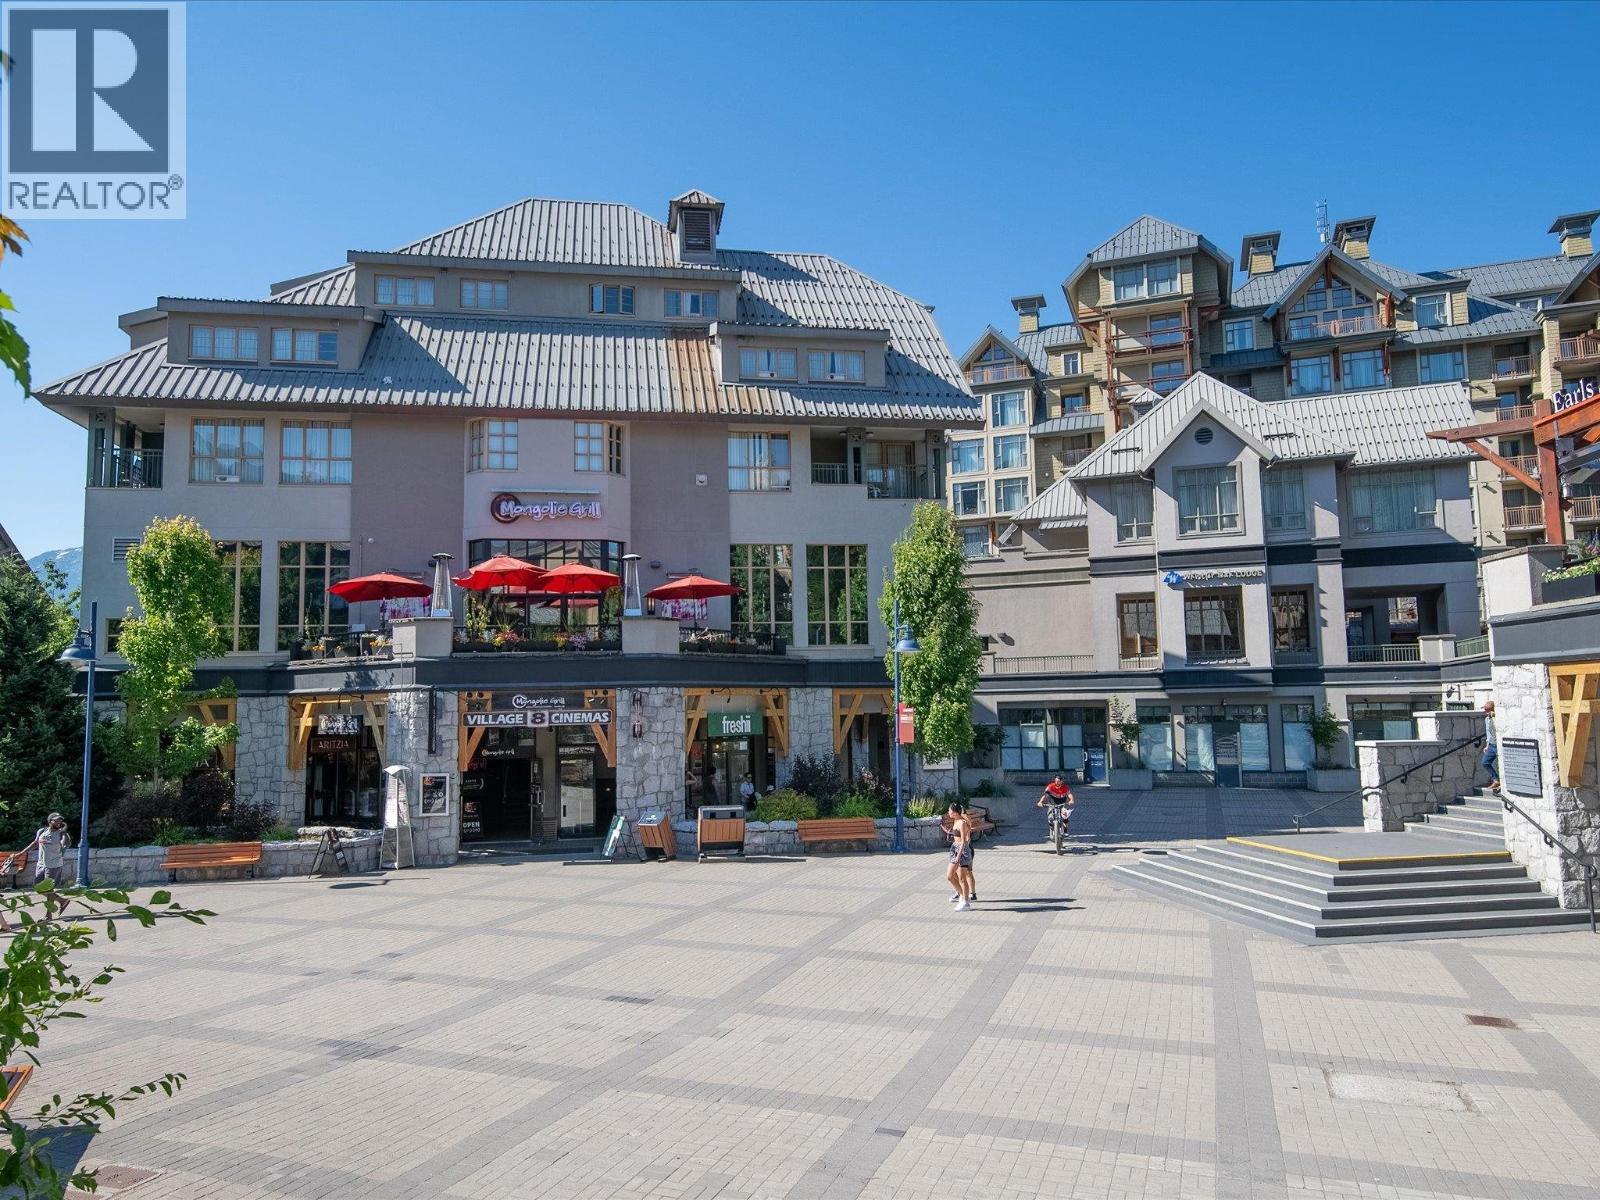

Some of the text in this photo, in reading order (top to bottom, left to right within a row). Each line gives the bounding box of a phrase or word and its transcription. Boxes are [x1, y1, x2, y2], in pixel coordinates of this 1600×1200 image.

[1552, 378, 1594, 413] Earls
[569, 501, 601, 518] Grill
[467, 712, 609, 725] VILLAGE 8 CINEMAS
[722, 715, 751, 734] freshii
[319, 740, 349, 749] ARITZIA
